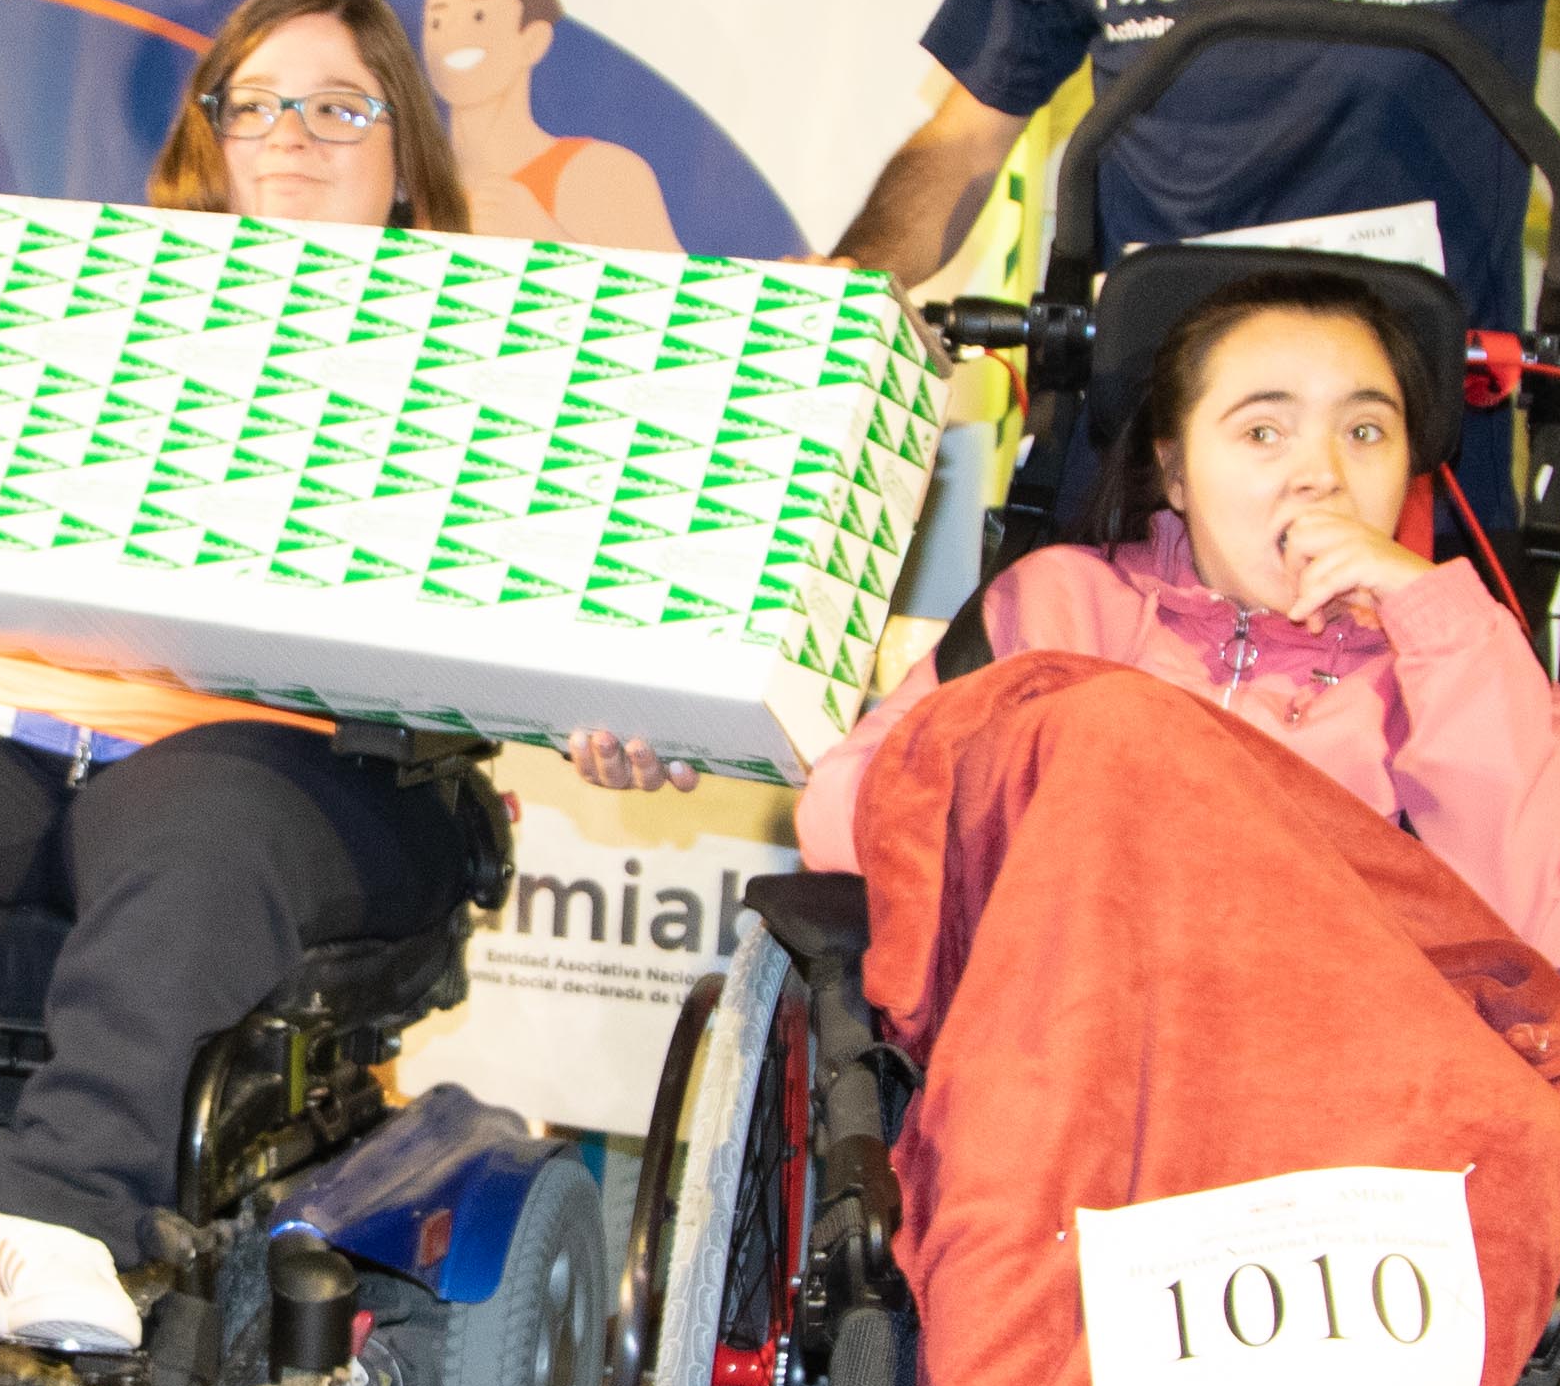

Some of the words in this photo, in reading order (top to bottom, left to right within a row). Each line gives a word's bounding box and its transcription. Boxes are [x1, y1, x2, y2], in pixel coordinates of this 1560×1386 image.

[472, 857, 748, 957] mia
[486, 946, 552, 968] Entidad
[555, 955, 645, 981] Asociativa
[507, 972, 558, 991] Social
[562, 980, 645, 1002] declarada
[1165, 1252, 1433, 1361] 1010
